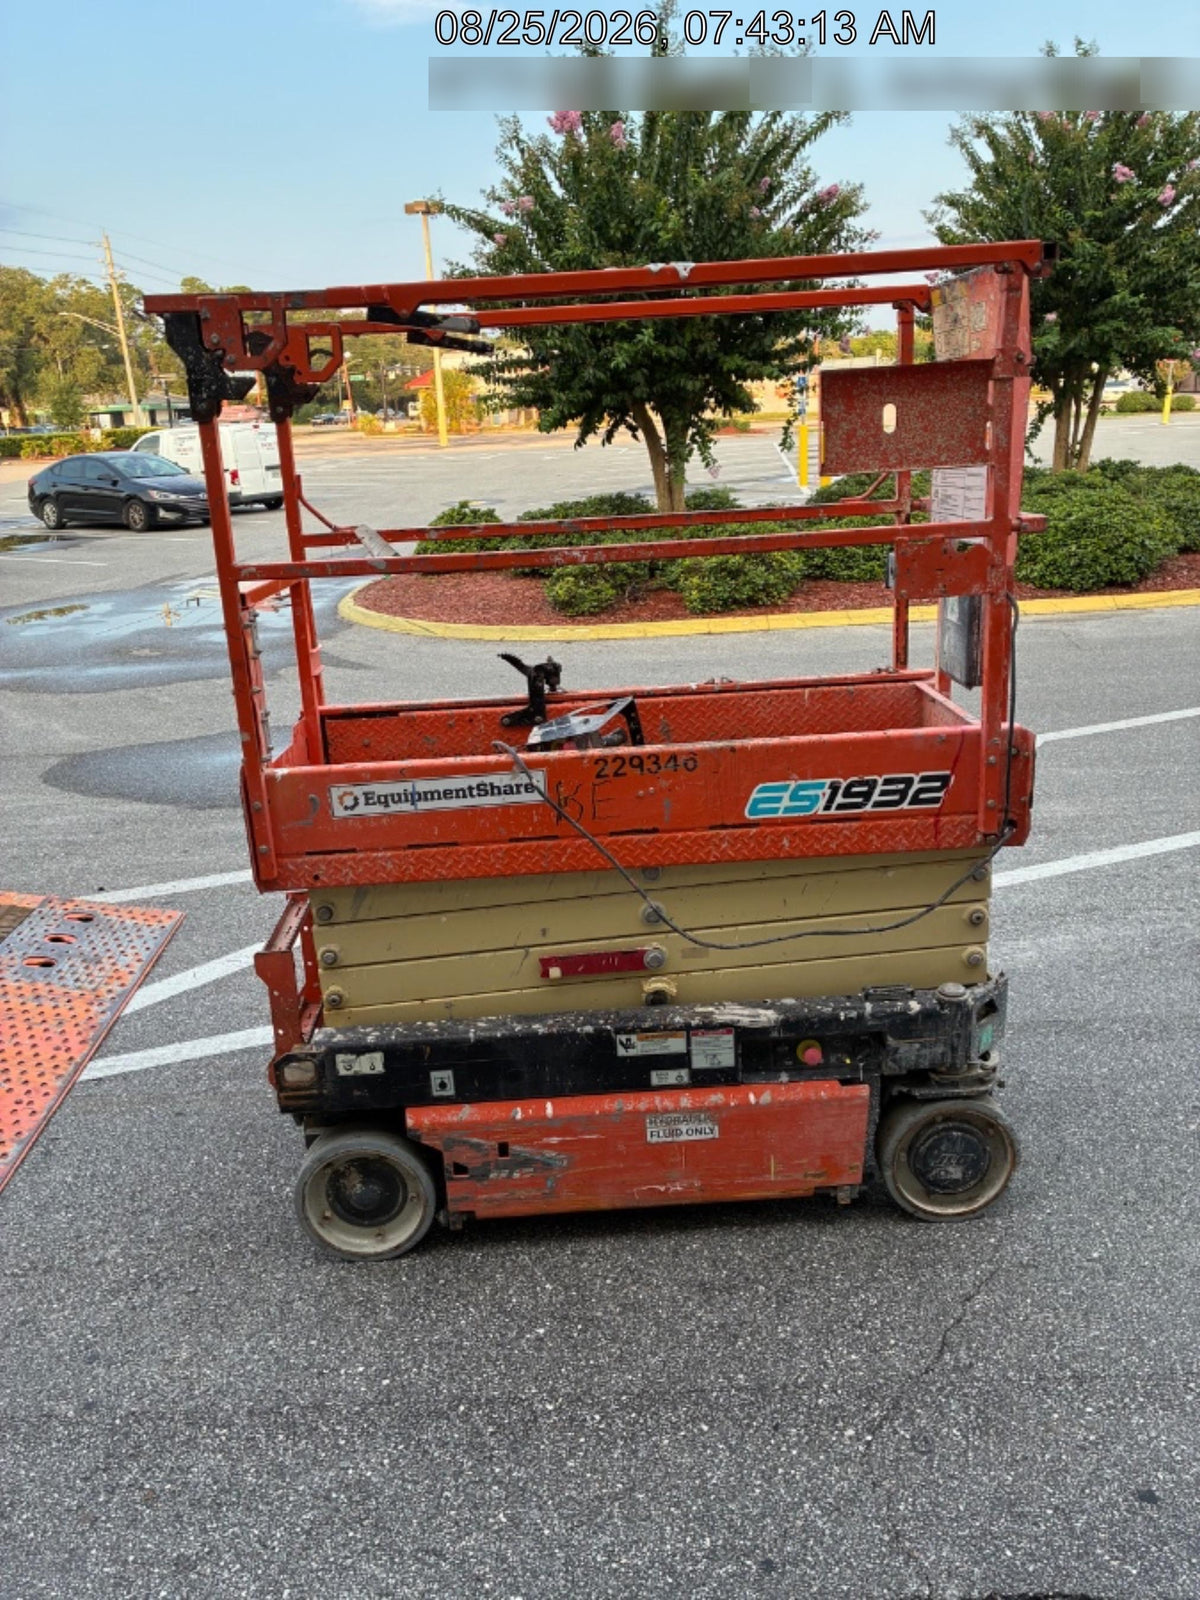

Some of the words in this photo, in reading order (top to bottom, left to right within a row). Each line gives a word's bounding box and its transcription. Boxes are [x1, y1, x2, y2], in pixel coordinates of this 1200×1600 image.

[362, 782, 536, 808] EquipmentShare
[746, 770, 953, 817] ES1932
[650, 1128, 683, 1139] FLUID
[686, 1126, 715, 1137] ONLY
